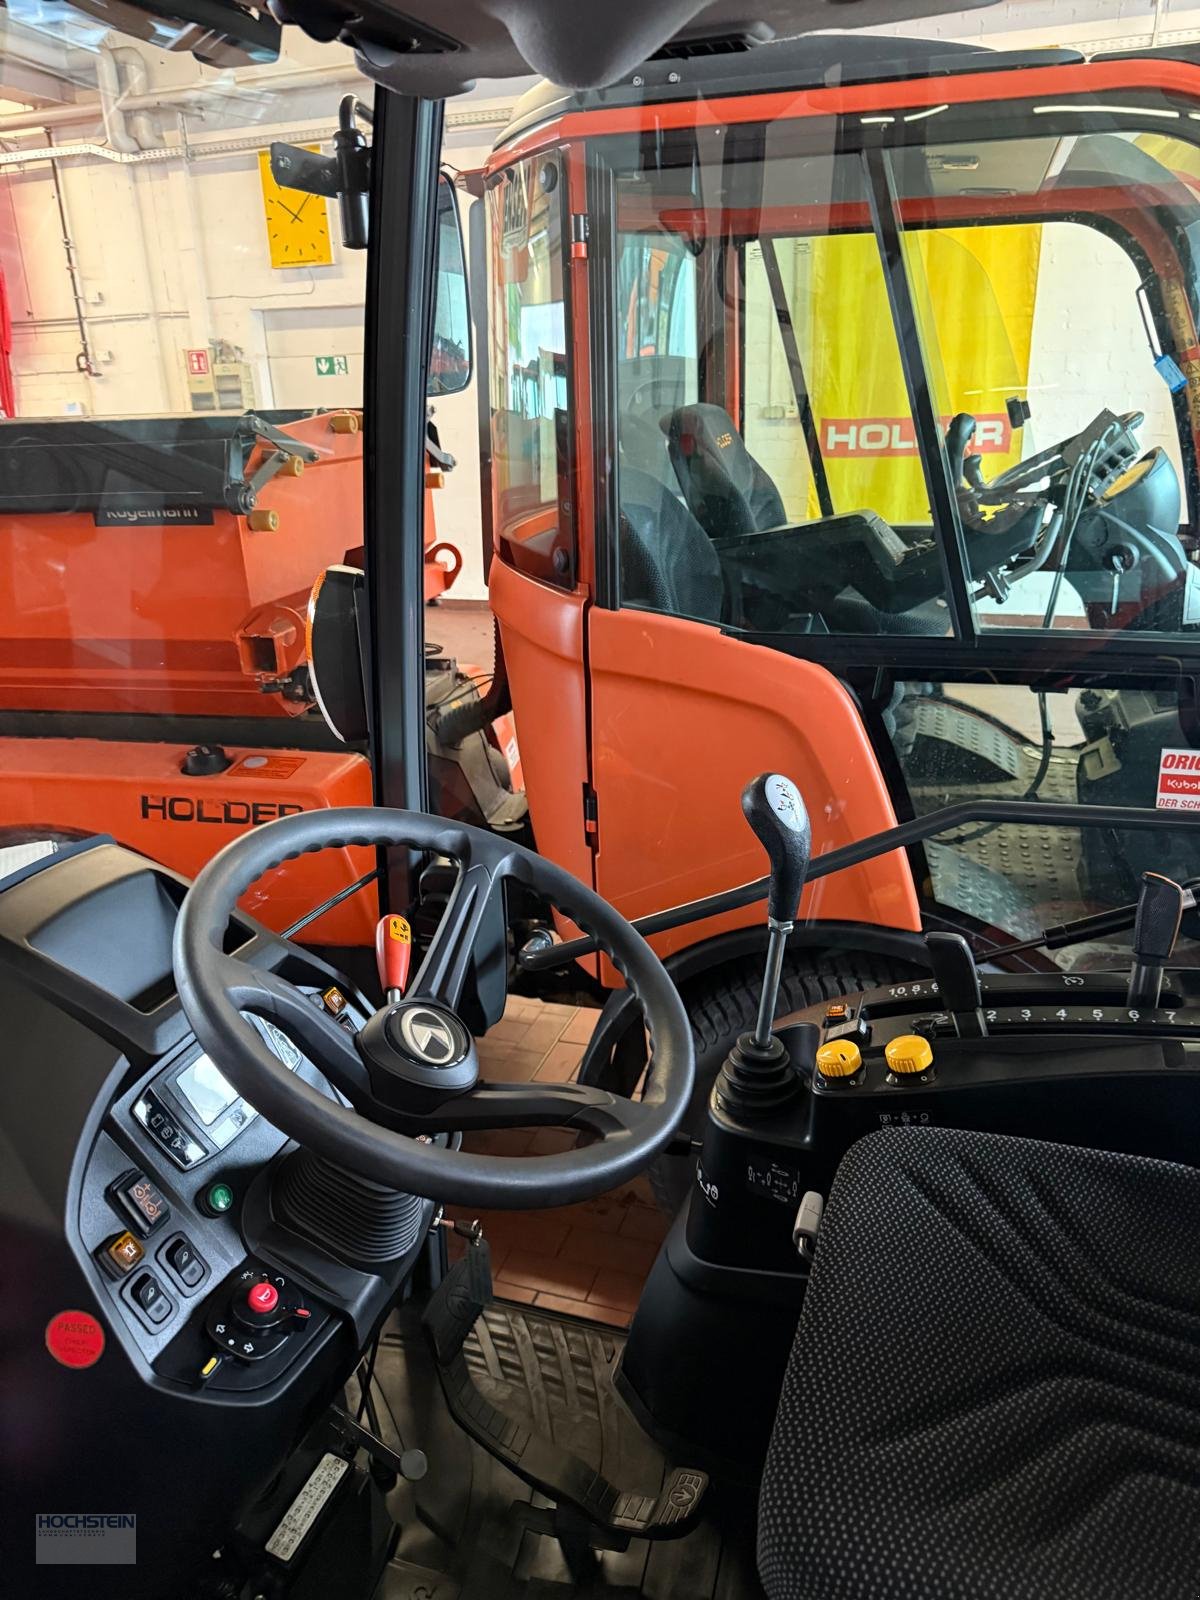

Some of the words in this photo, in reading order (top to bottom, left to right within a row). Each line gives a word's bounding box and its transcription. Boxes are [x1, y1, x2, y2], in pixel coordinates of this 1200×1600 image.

[826, 420, 1004, 452] HOLR
[1167, 779, 1200, 790] Kubo
[1157, 797, 1178, 808] DER
[986, 1010, 997, 1020] 2
[1021, 1009, 1031, 1019] 3
[1055, 1009, 1067, 1018] 4
[1092, 1009, 1103, 1018] 5
[1128, 1010, 1140, 1019] 6
[1165, 1011, 1176, 1021] 7
